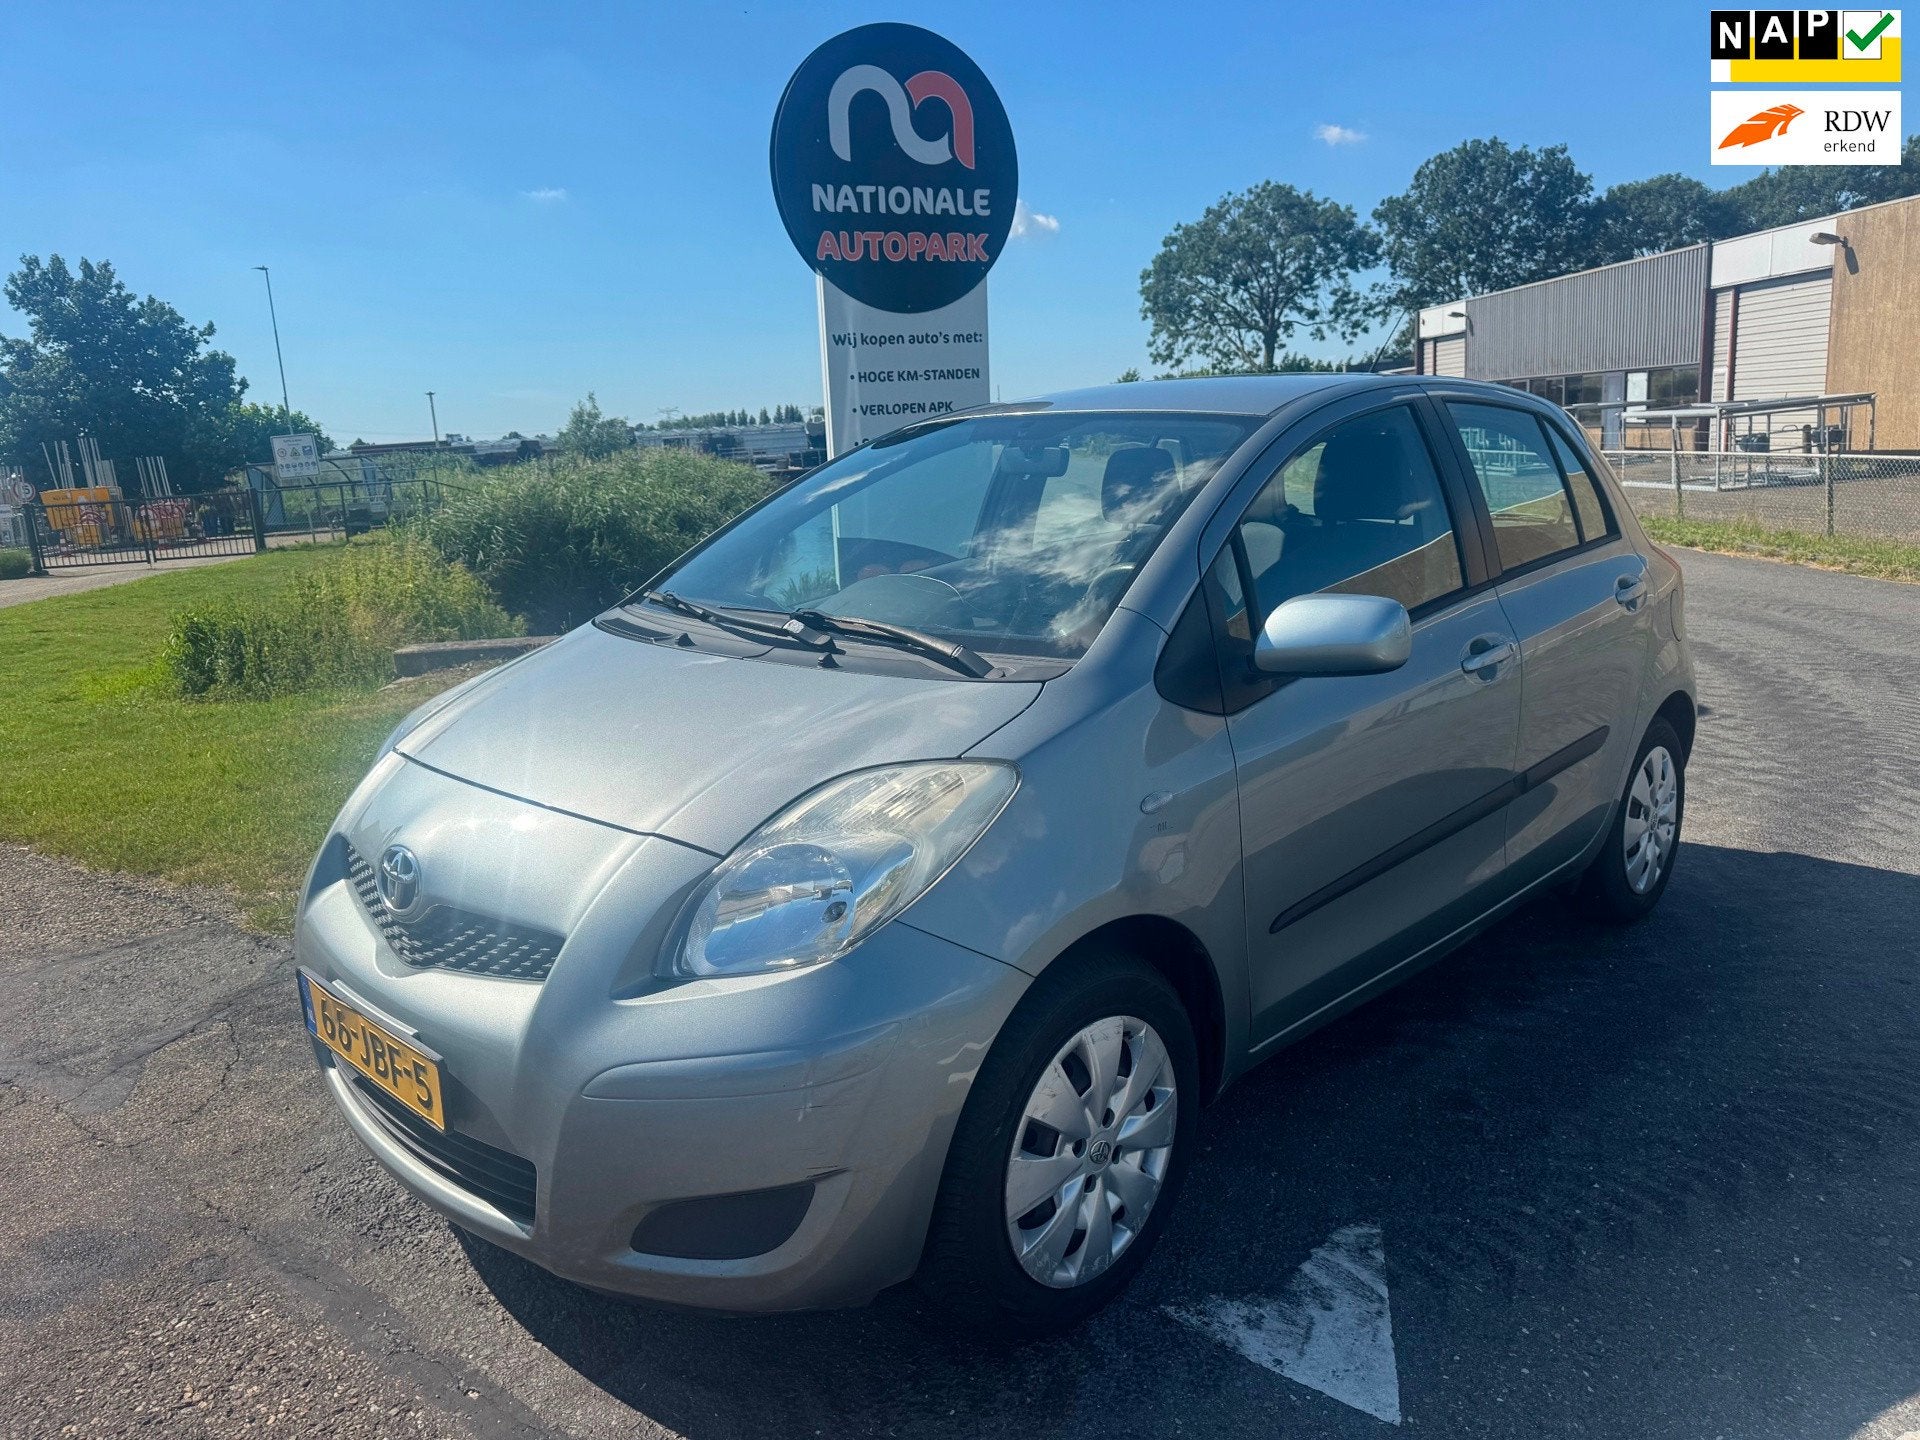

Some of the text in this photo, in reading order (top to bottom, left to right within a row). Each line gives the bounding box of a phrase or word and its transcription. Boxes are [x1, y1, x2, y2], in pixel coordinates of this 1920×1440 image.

[811, 183, 991, 216] NATIONALE
[816, 230, 990, 262] AUTOPARK
[832, 330, 983, 348] Wij kopen auto’s met:
[858, 367, 980, 383] HOGE KM-STANDEN
[860, 400, 953, 416] VERLOPEN APK
[321, 998, 433, 1111] 66-JBF-5
